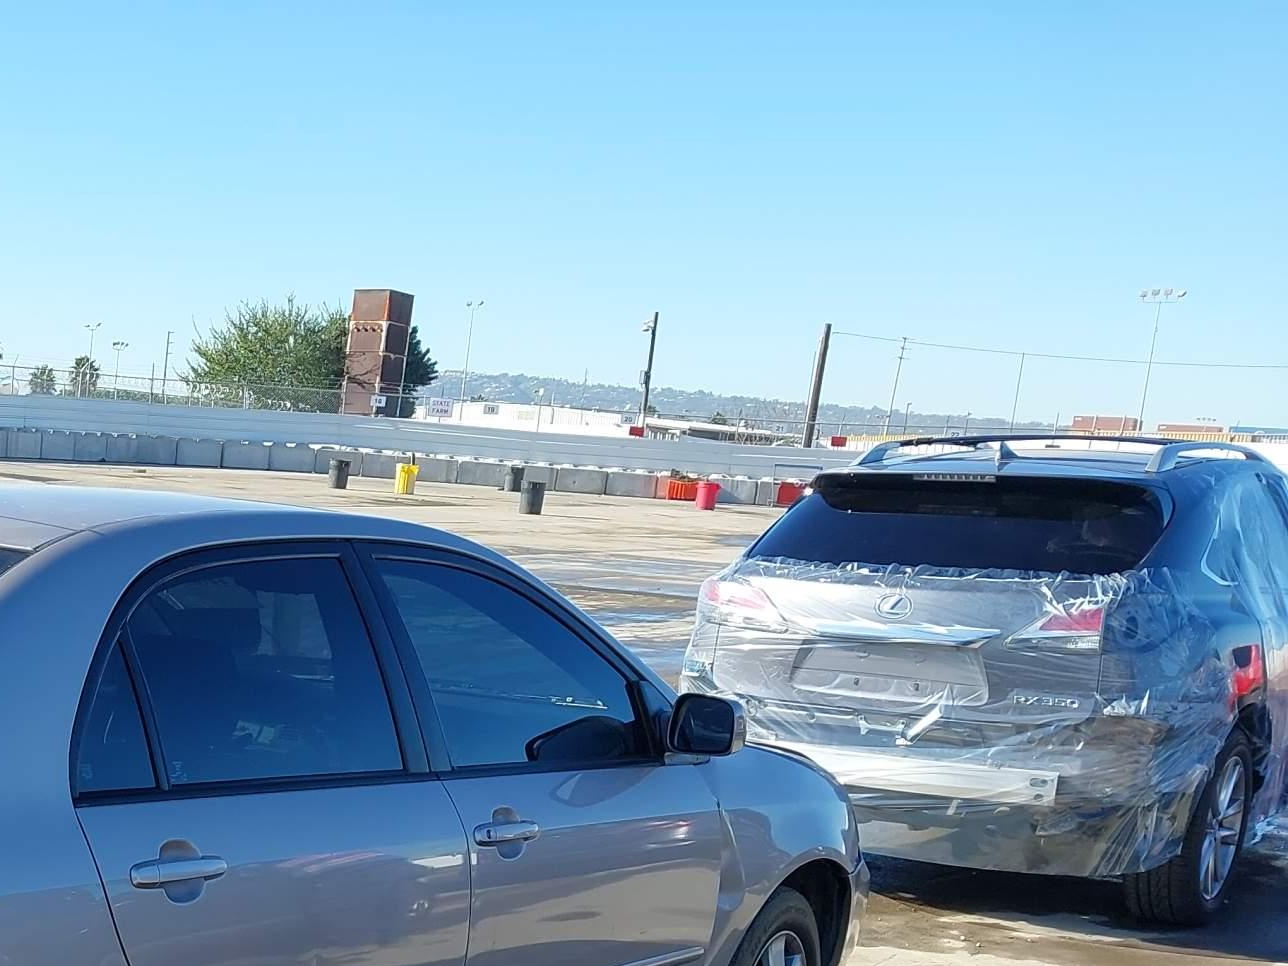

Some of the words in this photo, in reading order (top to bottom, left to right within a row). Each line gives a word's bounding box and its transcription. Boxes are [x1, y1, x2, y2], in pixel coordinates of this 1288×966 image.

[431, 399, 450, 407] STATE
[431, 407, 449, 415] FARM
[623, 415, 633, 423] 20
[1013, 695, 1040, 706] RX
